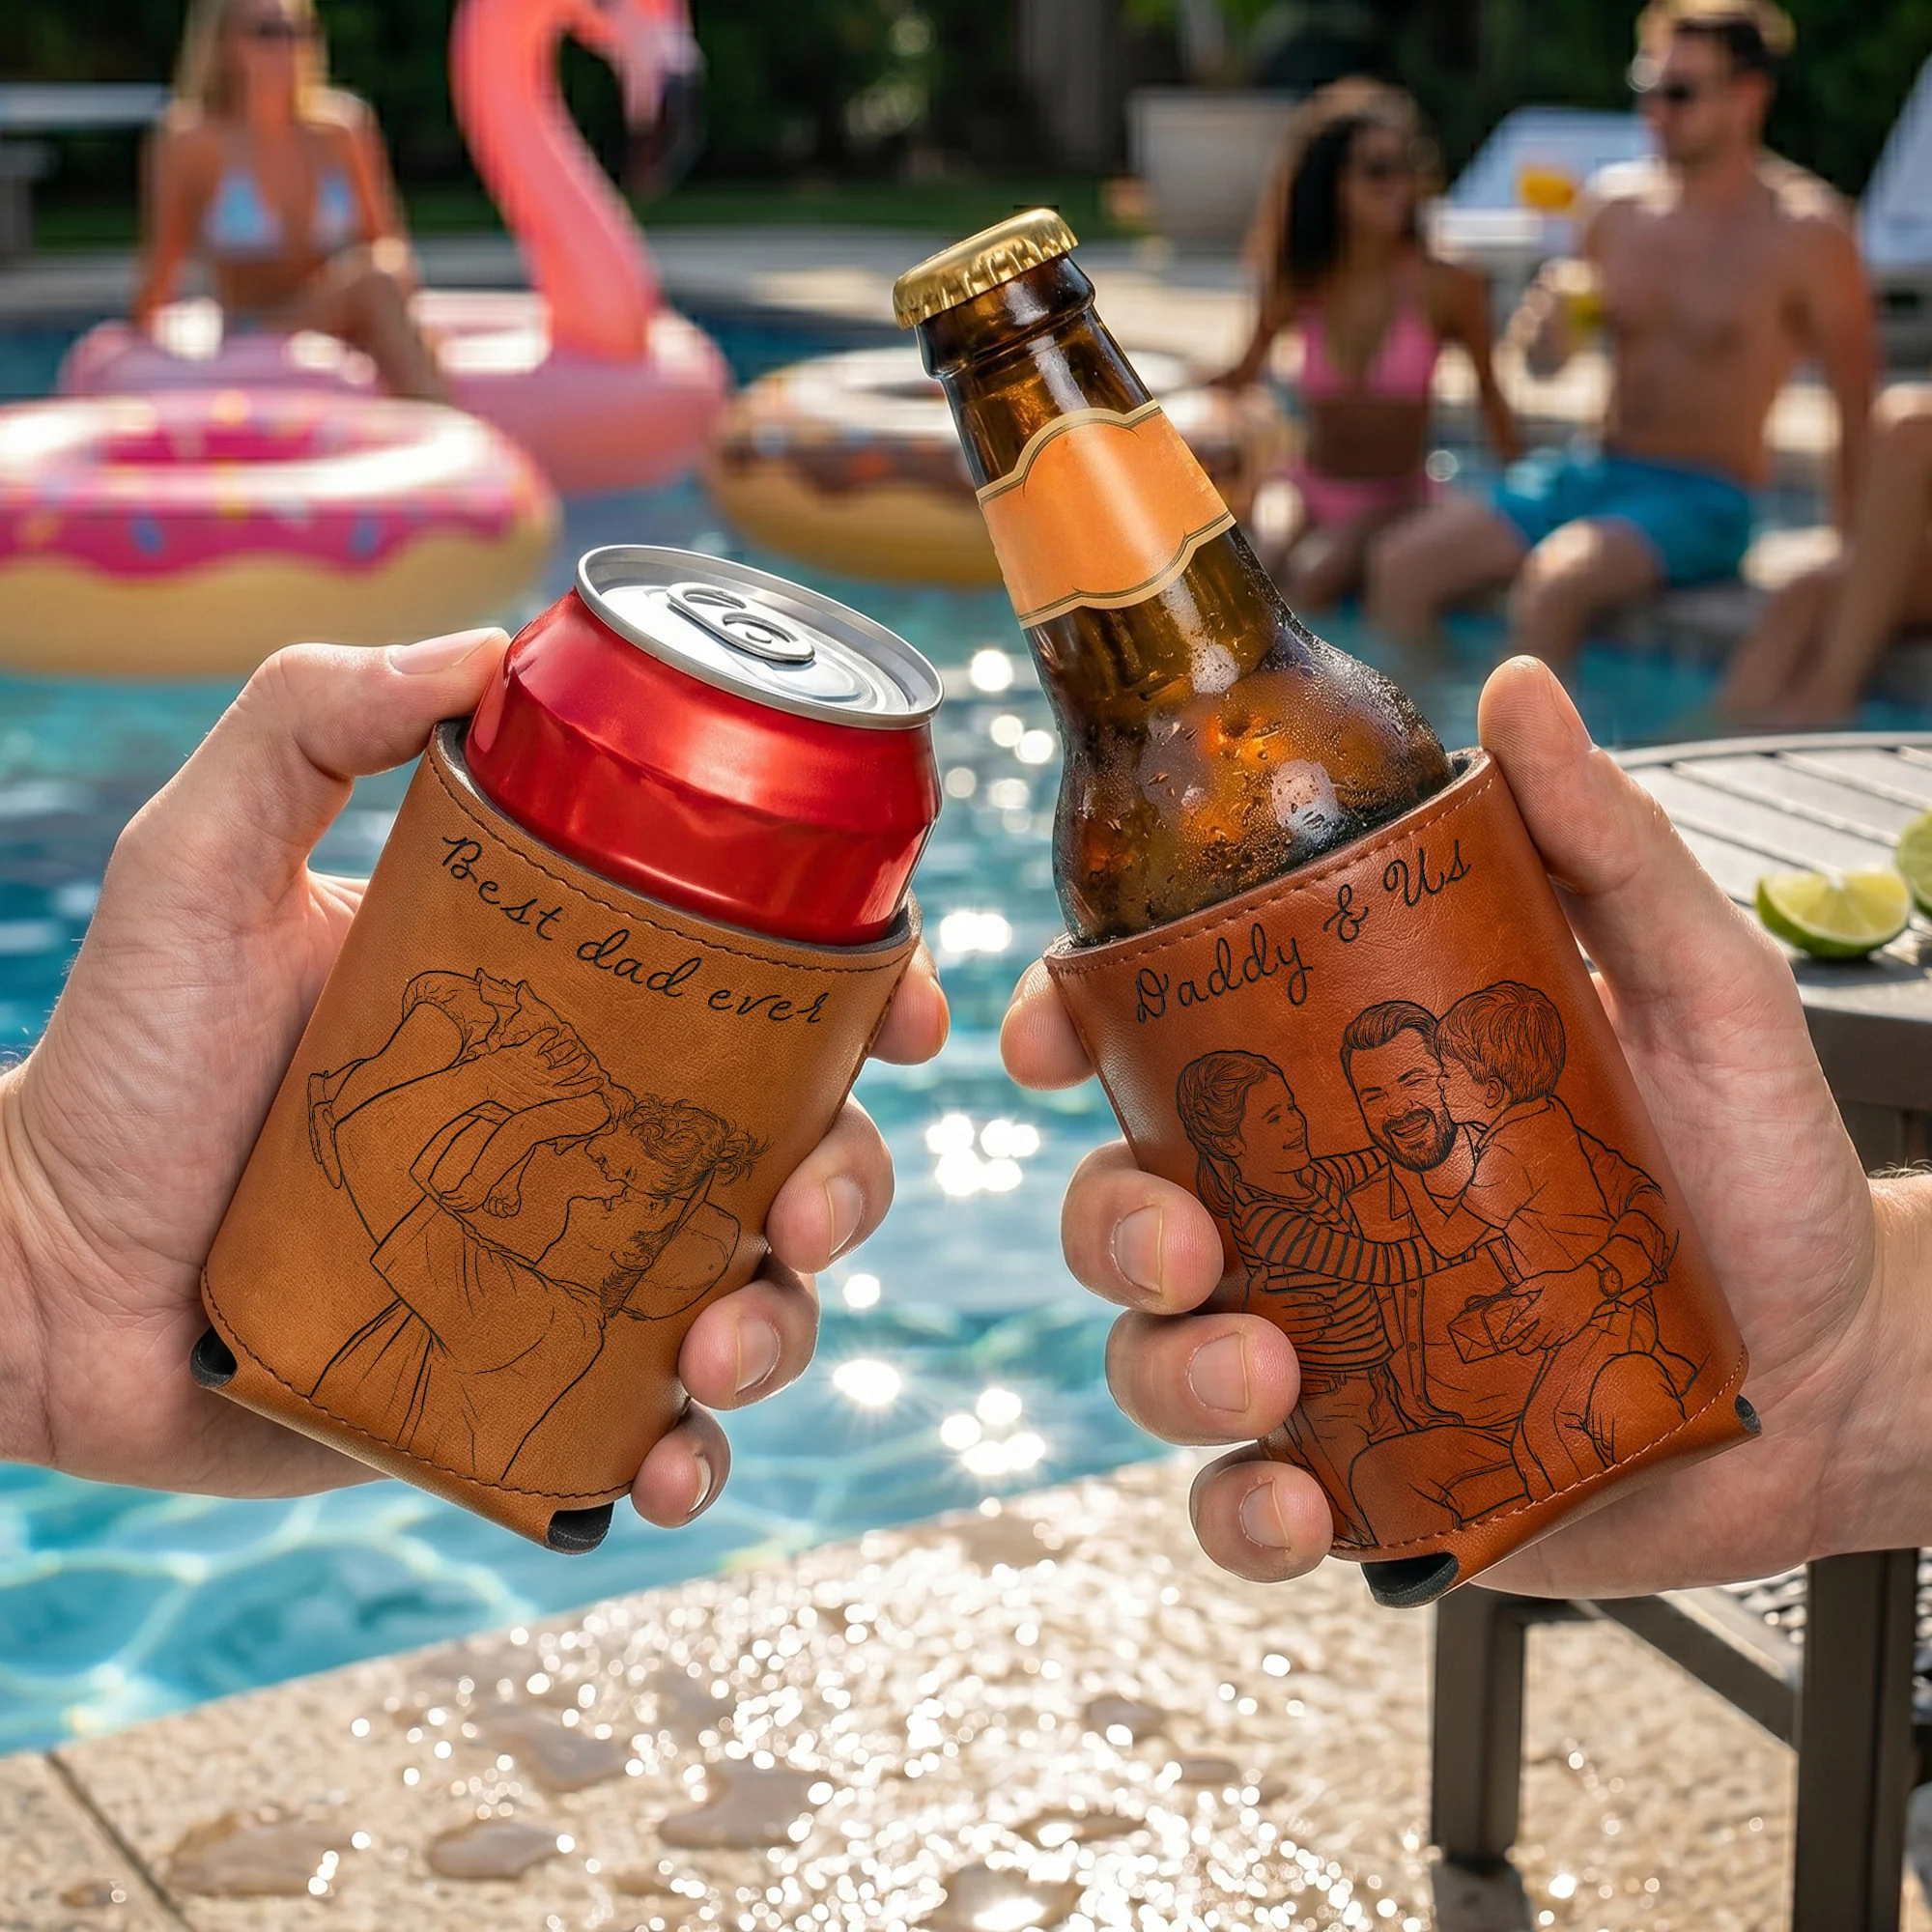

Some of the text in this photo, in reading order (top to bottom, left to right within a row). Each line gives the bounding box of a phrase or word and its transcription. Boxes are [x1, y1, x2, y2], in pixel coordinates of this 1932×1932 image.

[441, 836, 830, 1024] Best dad ever
[1135, 838, 1471, 1024] Daddy & Us
